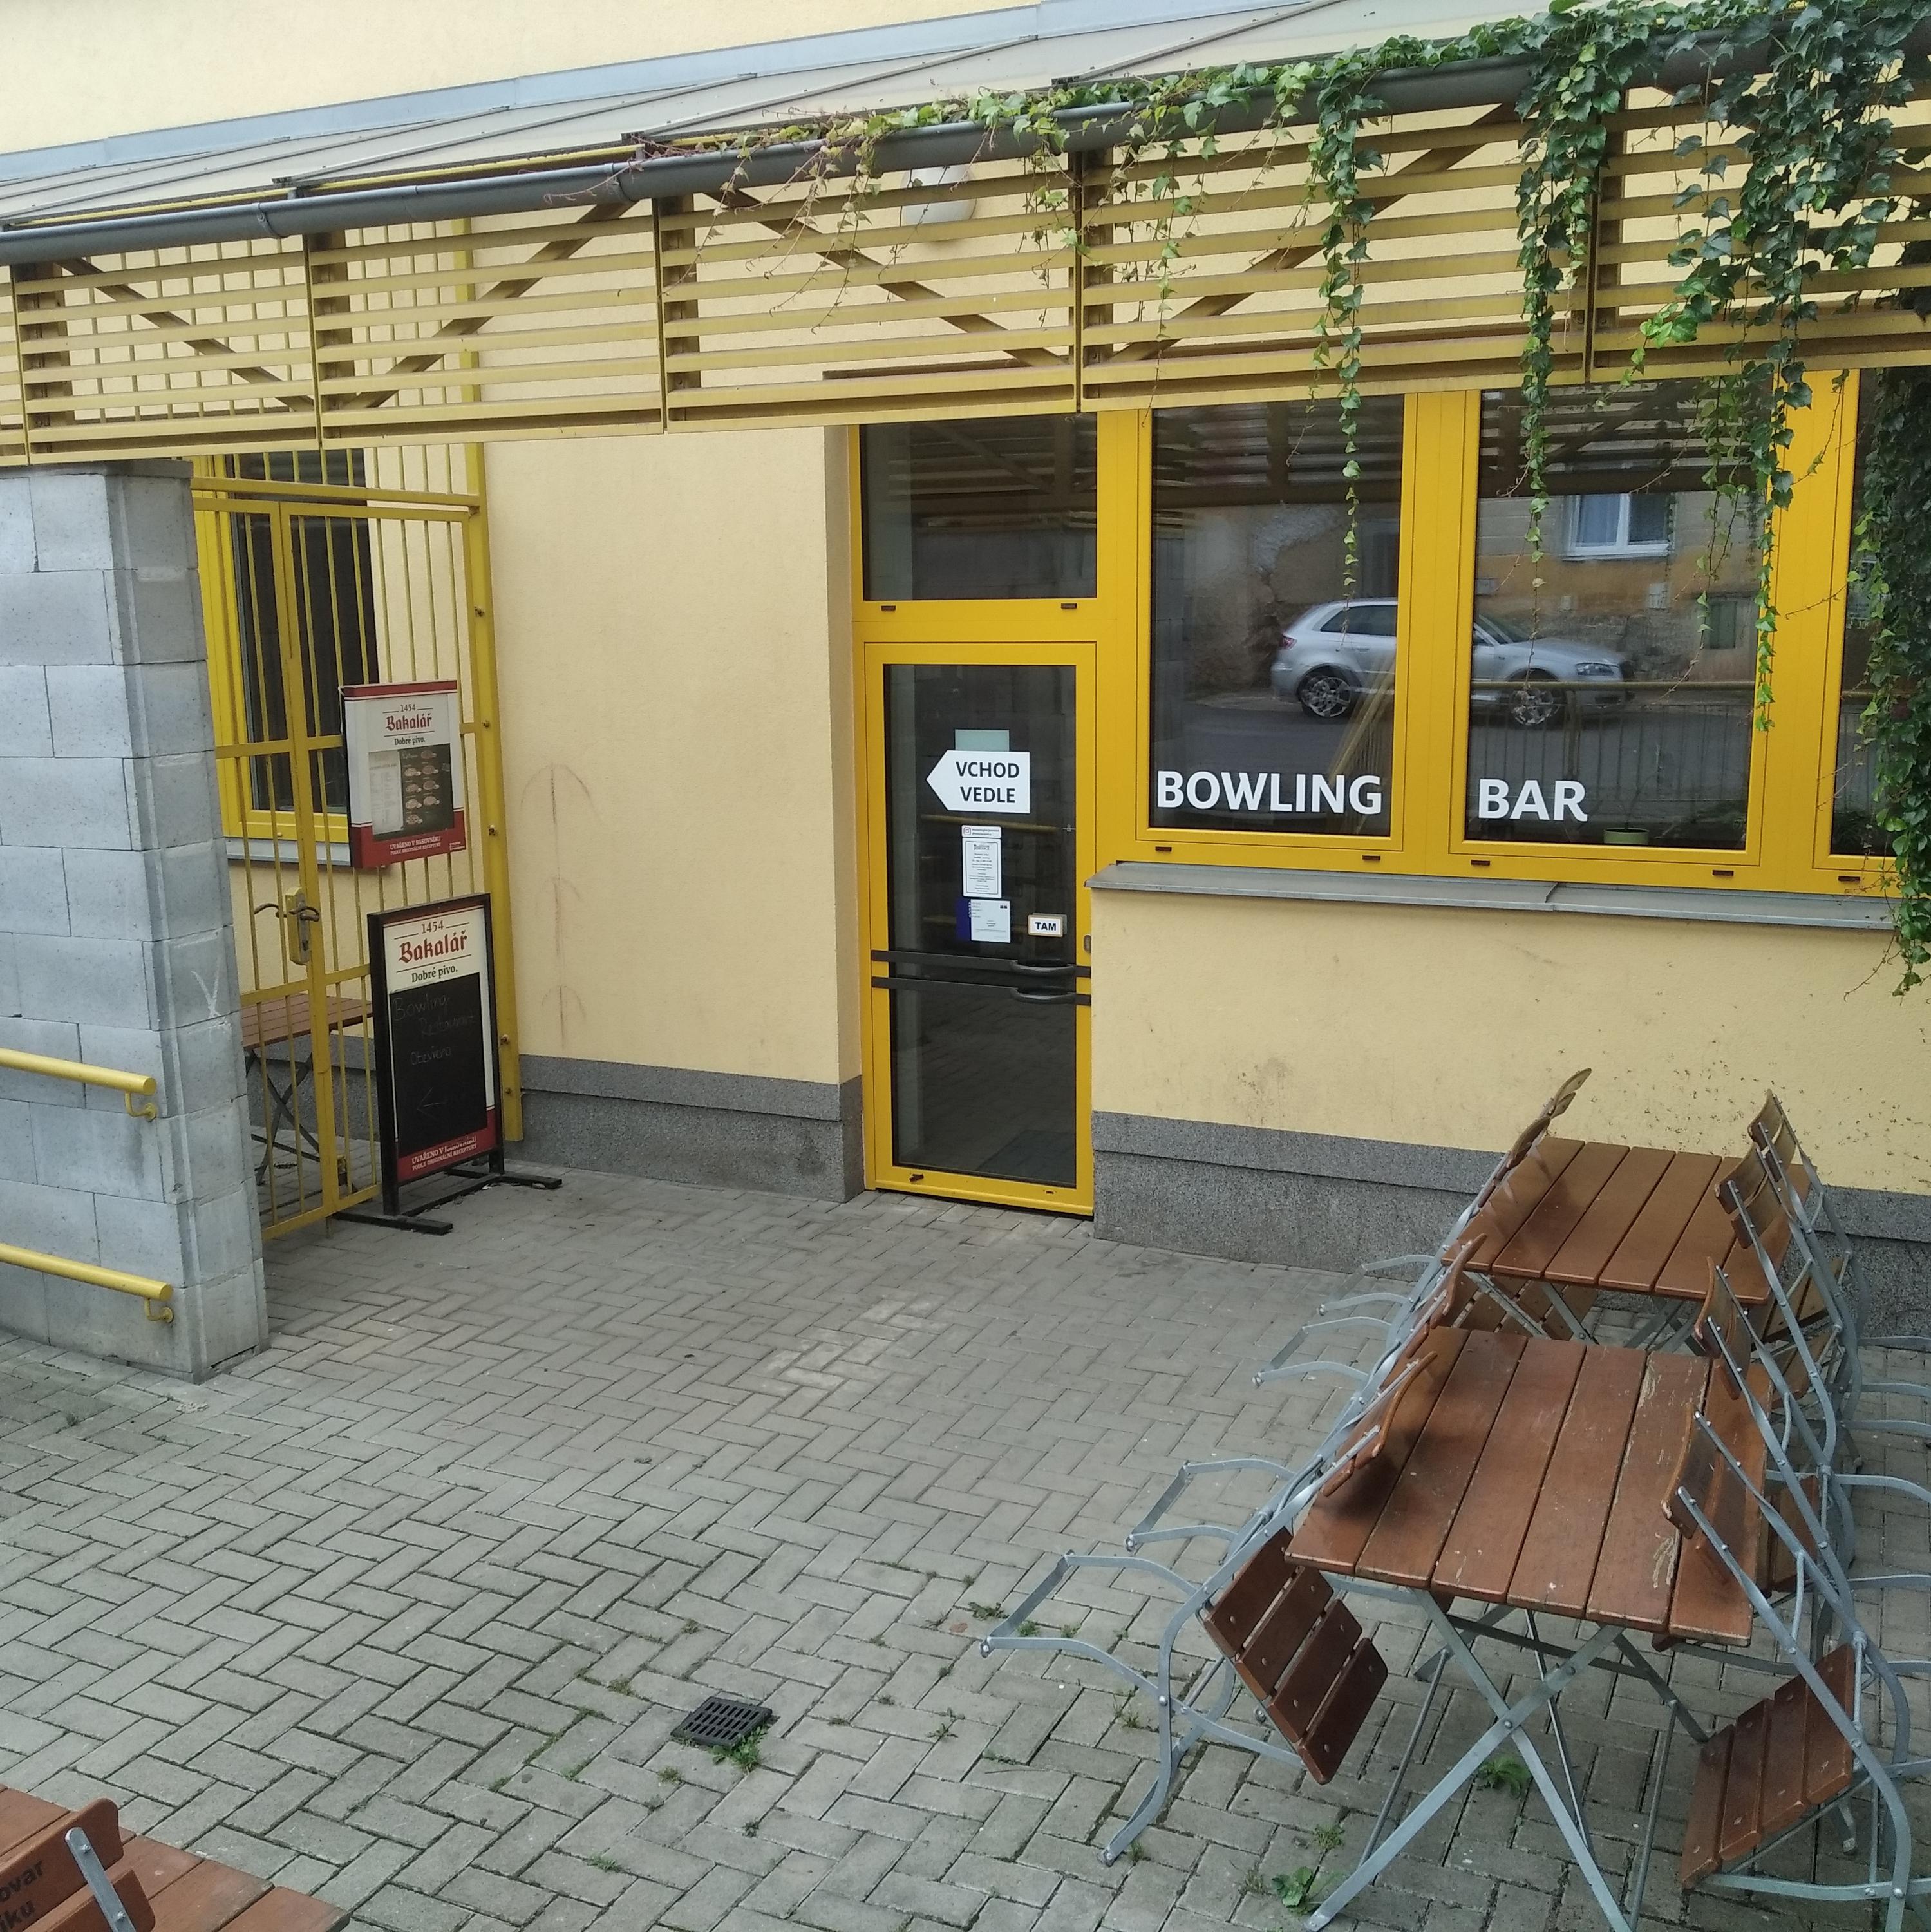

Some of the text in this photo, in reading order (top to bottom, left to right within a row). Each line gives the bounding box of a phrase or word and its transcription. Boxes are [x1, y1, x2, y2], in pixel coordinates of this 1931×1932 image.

[385, 713, 432, 732] Bakalář
[394, 737, 411, 746] Dobré
[956, 761, 1019, 778] VCHOD
[960, 786, 1015, 803] VEDLE
[1157, 770, 1588, 822] BOWLING BAR
[422, 920, 444, 934] 1454
[1035, 922, 1057, 931] TAM
[398, 930, 467, 963] Bakalář
[411, 965, 458, 982] Dobré pivo.
[411, 1150, 438, 1164] UVAŘENO
